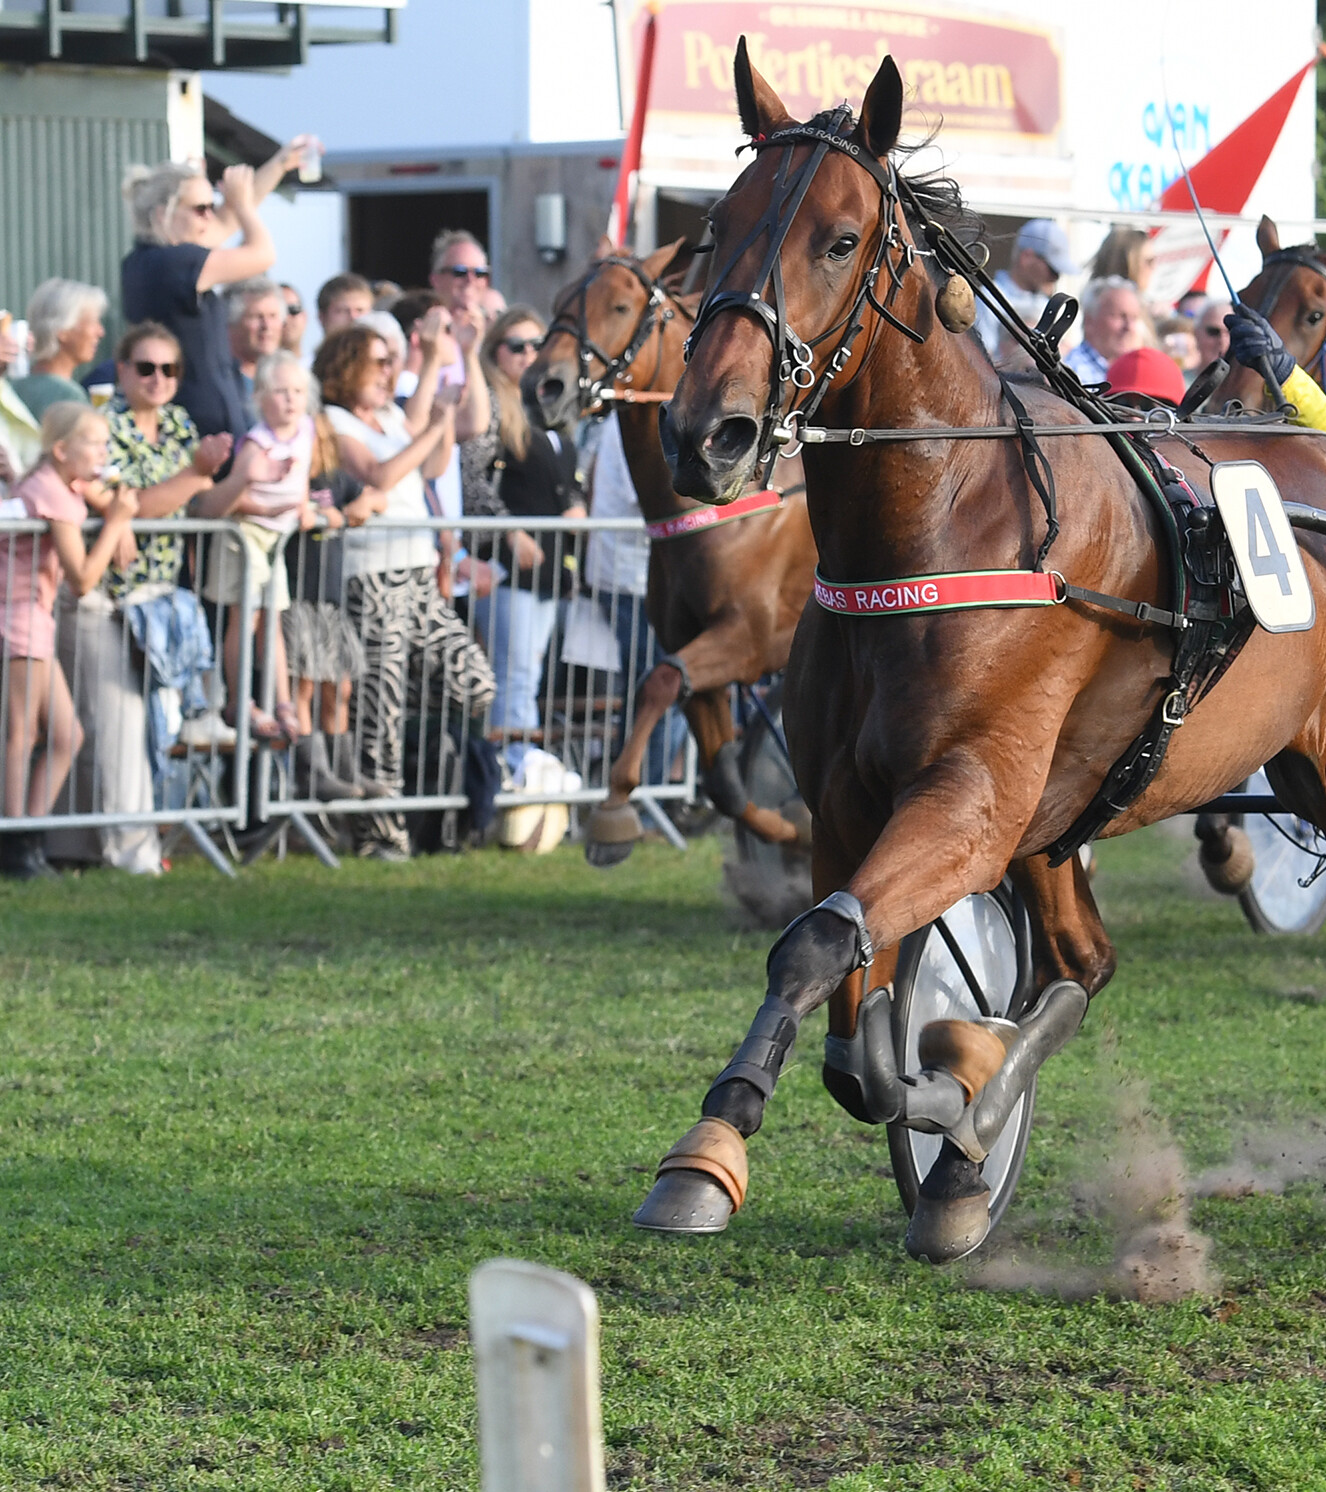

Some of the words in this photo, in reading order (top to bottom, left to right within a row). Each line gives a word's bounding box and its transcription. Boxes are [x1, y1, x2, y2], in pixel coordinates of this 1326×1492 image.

[816, 130, 860, 155] RACING
[1245, 488, 1293, 596] 4
[855, 583, 939, 610] RACING
